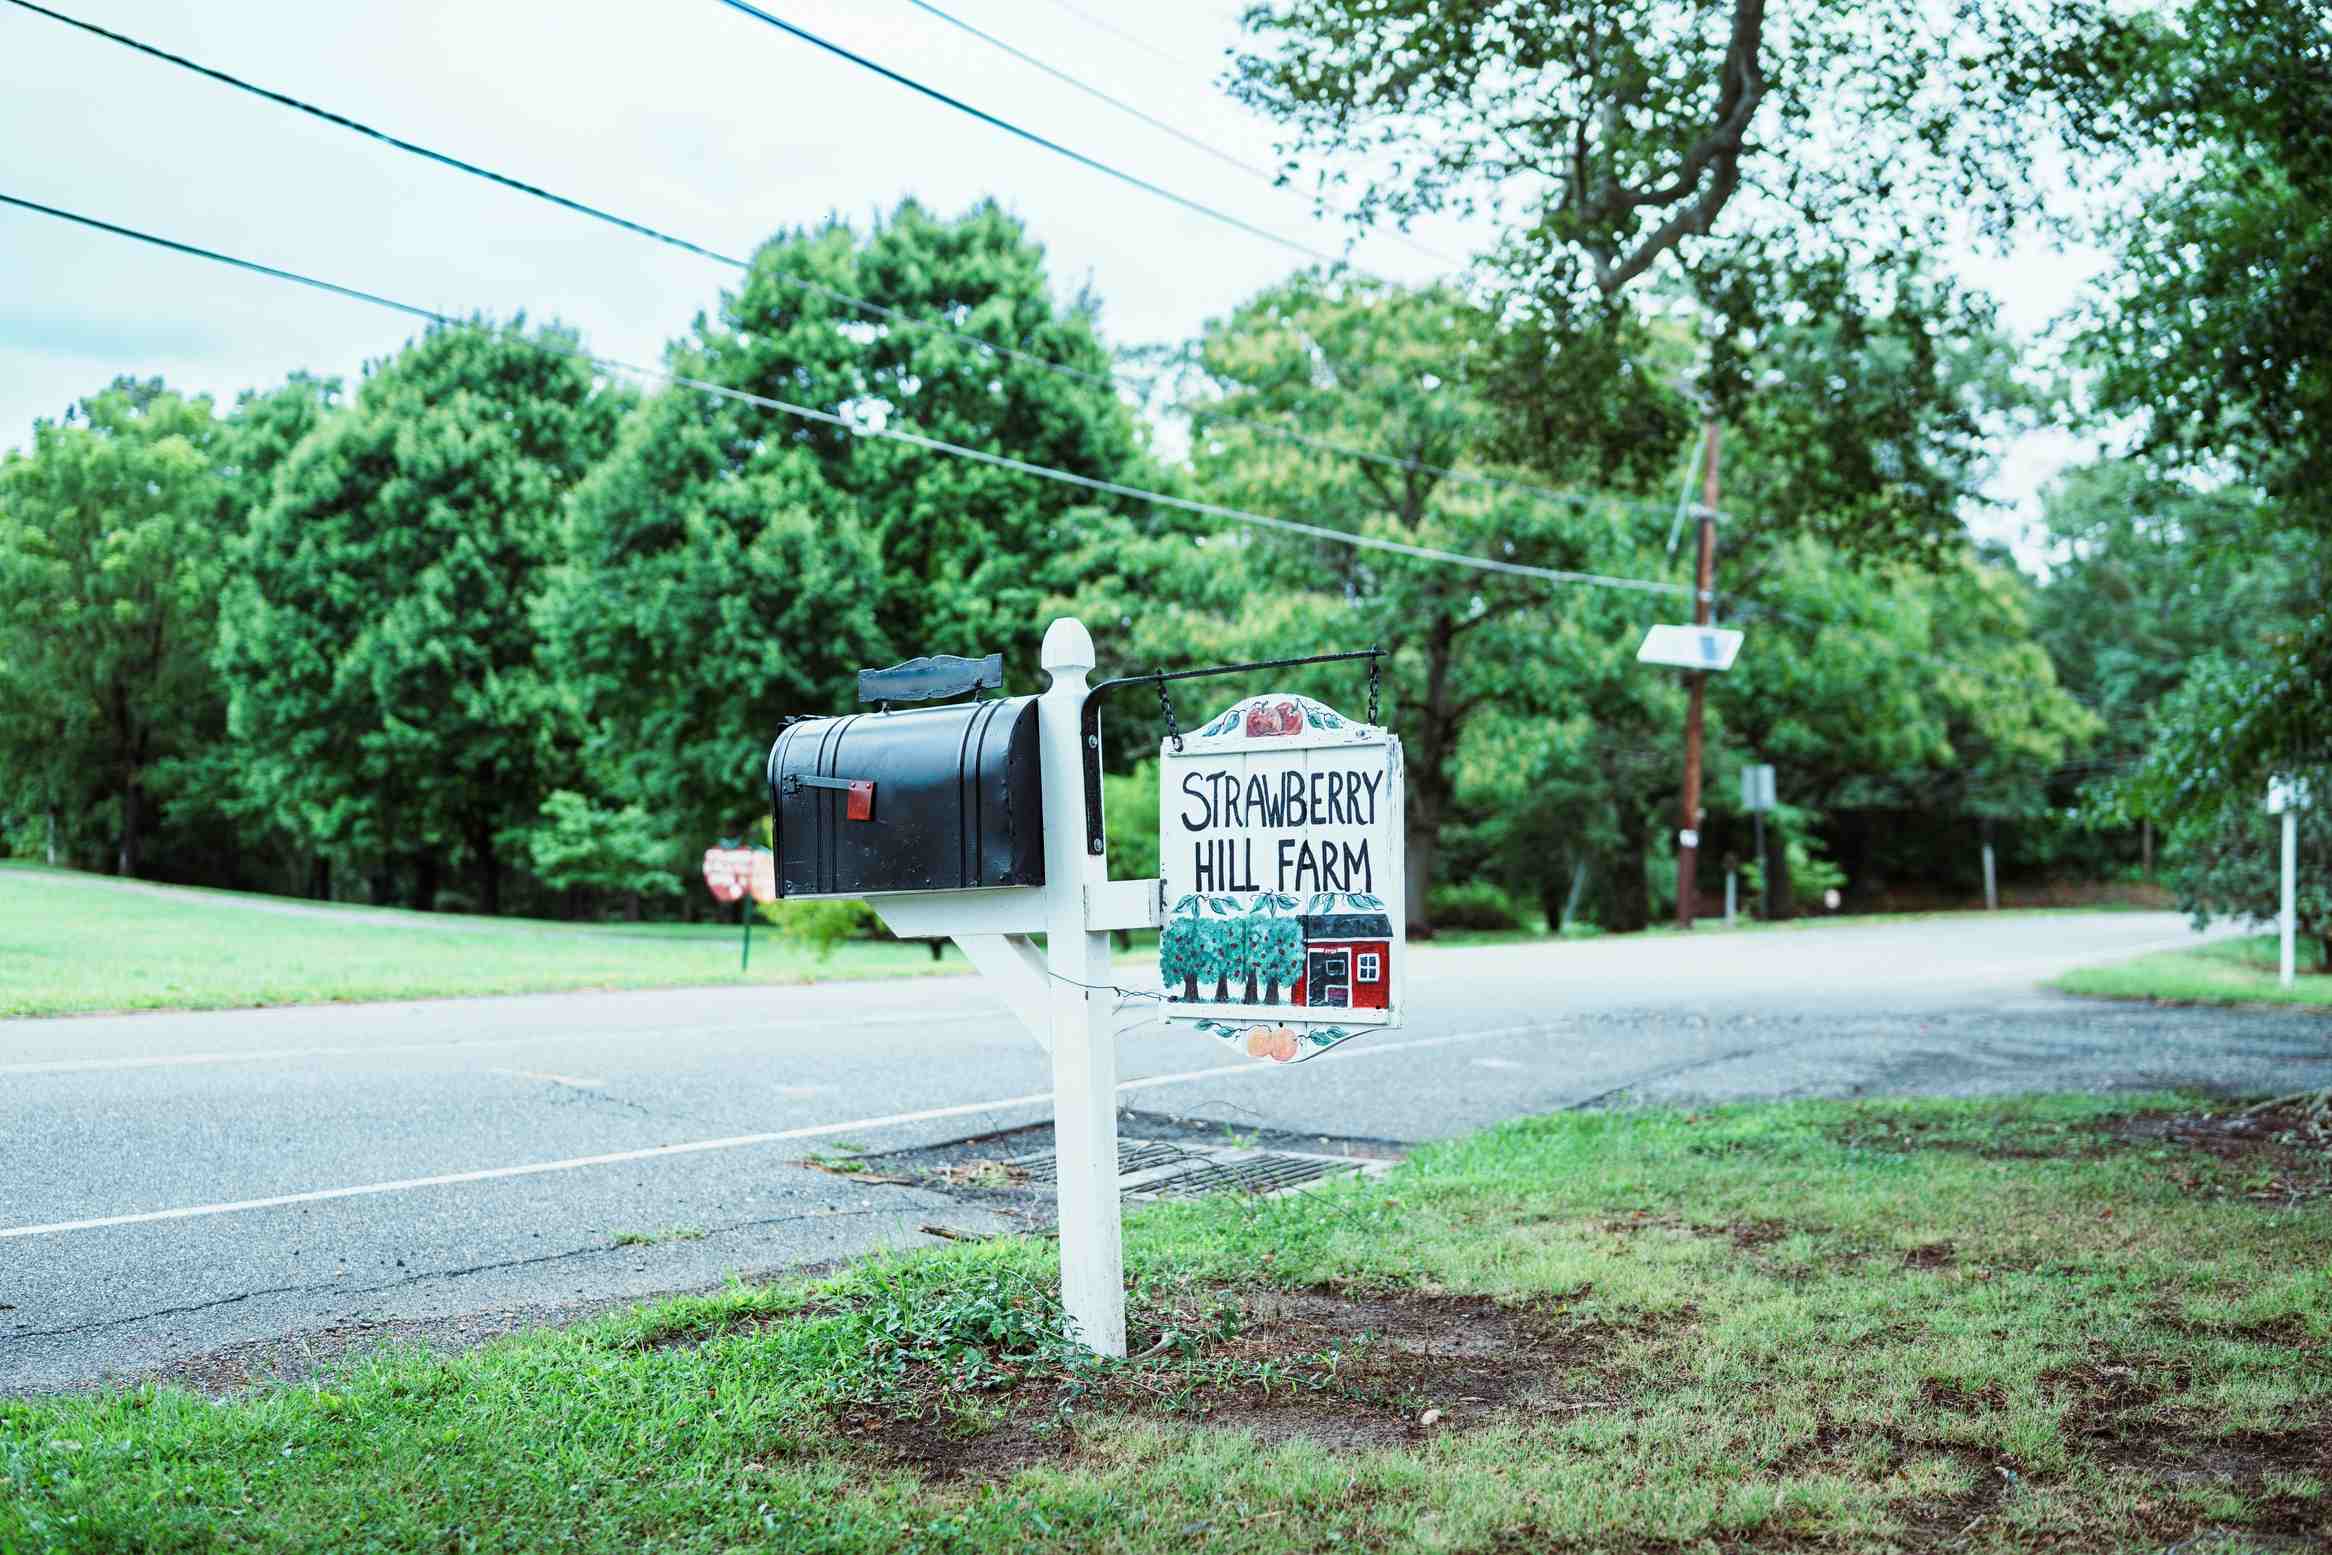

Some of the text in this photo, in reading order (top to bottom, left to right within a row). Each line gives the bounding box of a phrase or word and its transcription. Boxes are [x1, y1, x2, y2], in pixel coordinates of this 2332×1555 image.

[1181, 770, 1383, 832] STRAWBERRY
[1195, 838, 1372, 893] HILL FARM
